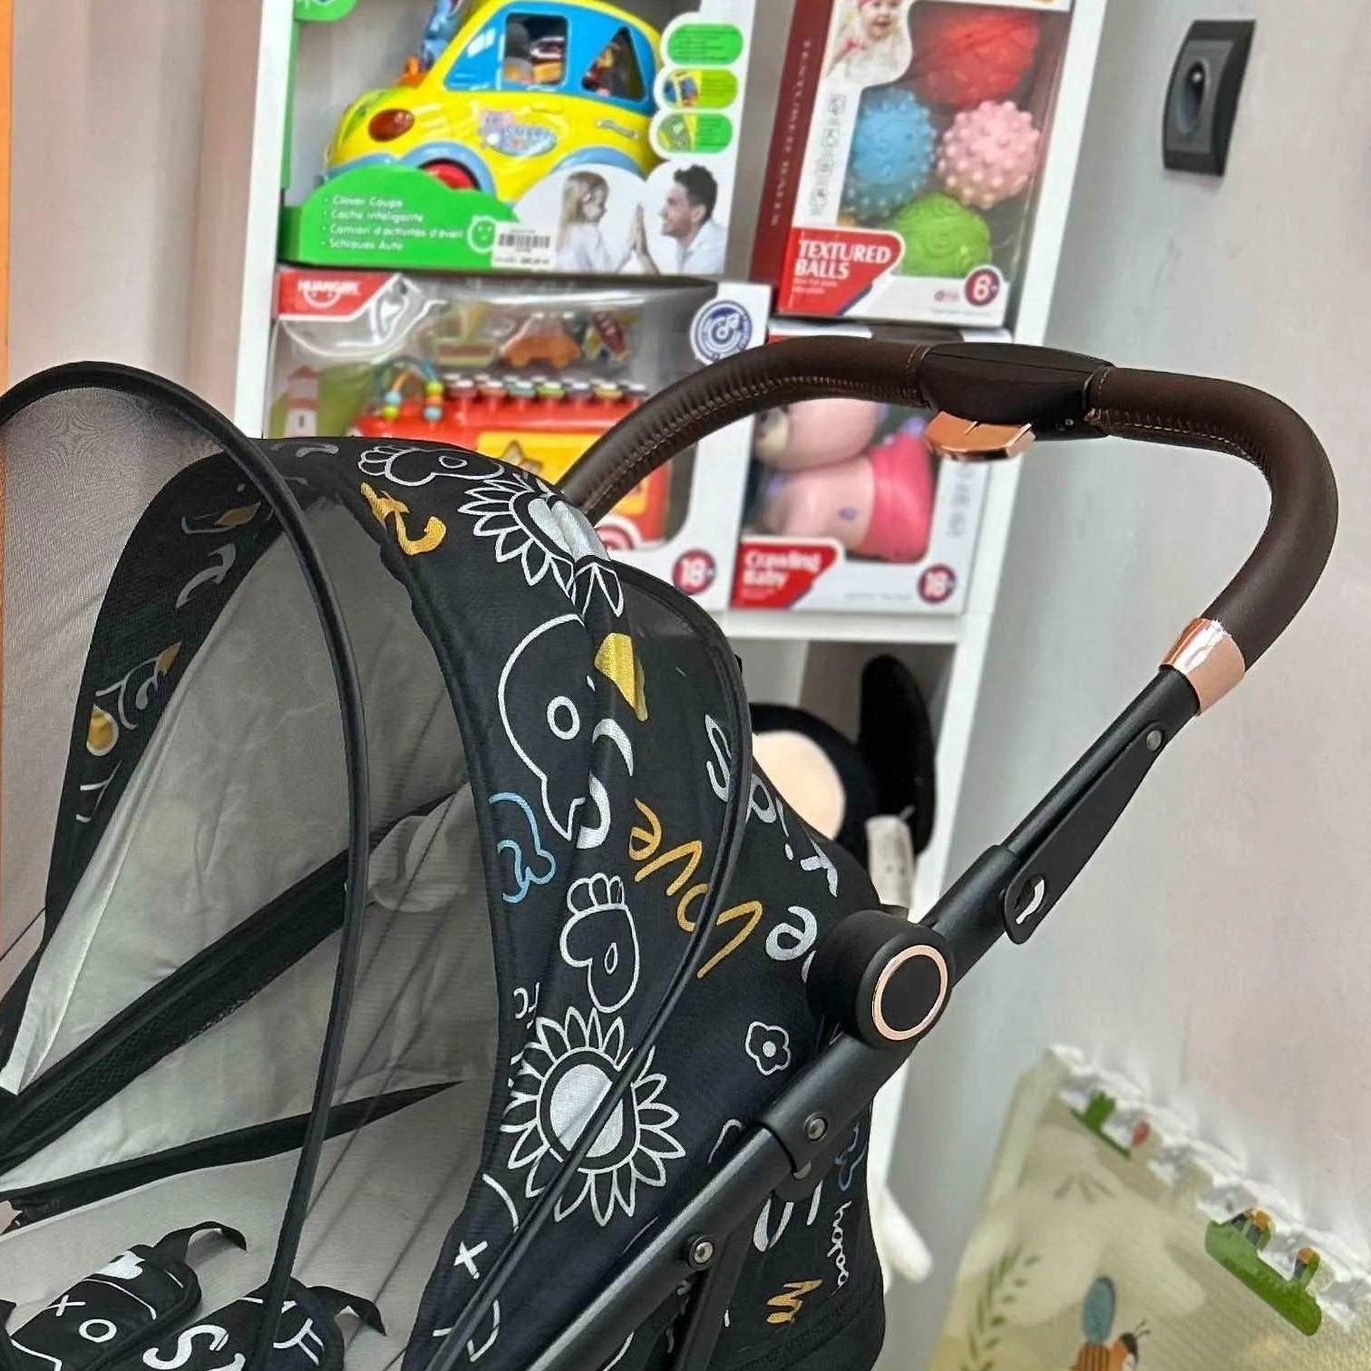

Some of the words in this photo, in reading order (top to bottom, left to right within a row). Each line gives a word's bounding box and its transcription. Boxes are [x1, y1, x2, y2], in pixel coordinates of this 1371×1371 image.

[798, 239, 891, 265] TEXTURED
[795, 257, 850, 280] BALLS
[629, 797, 763, 979] love
